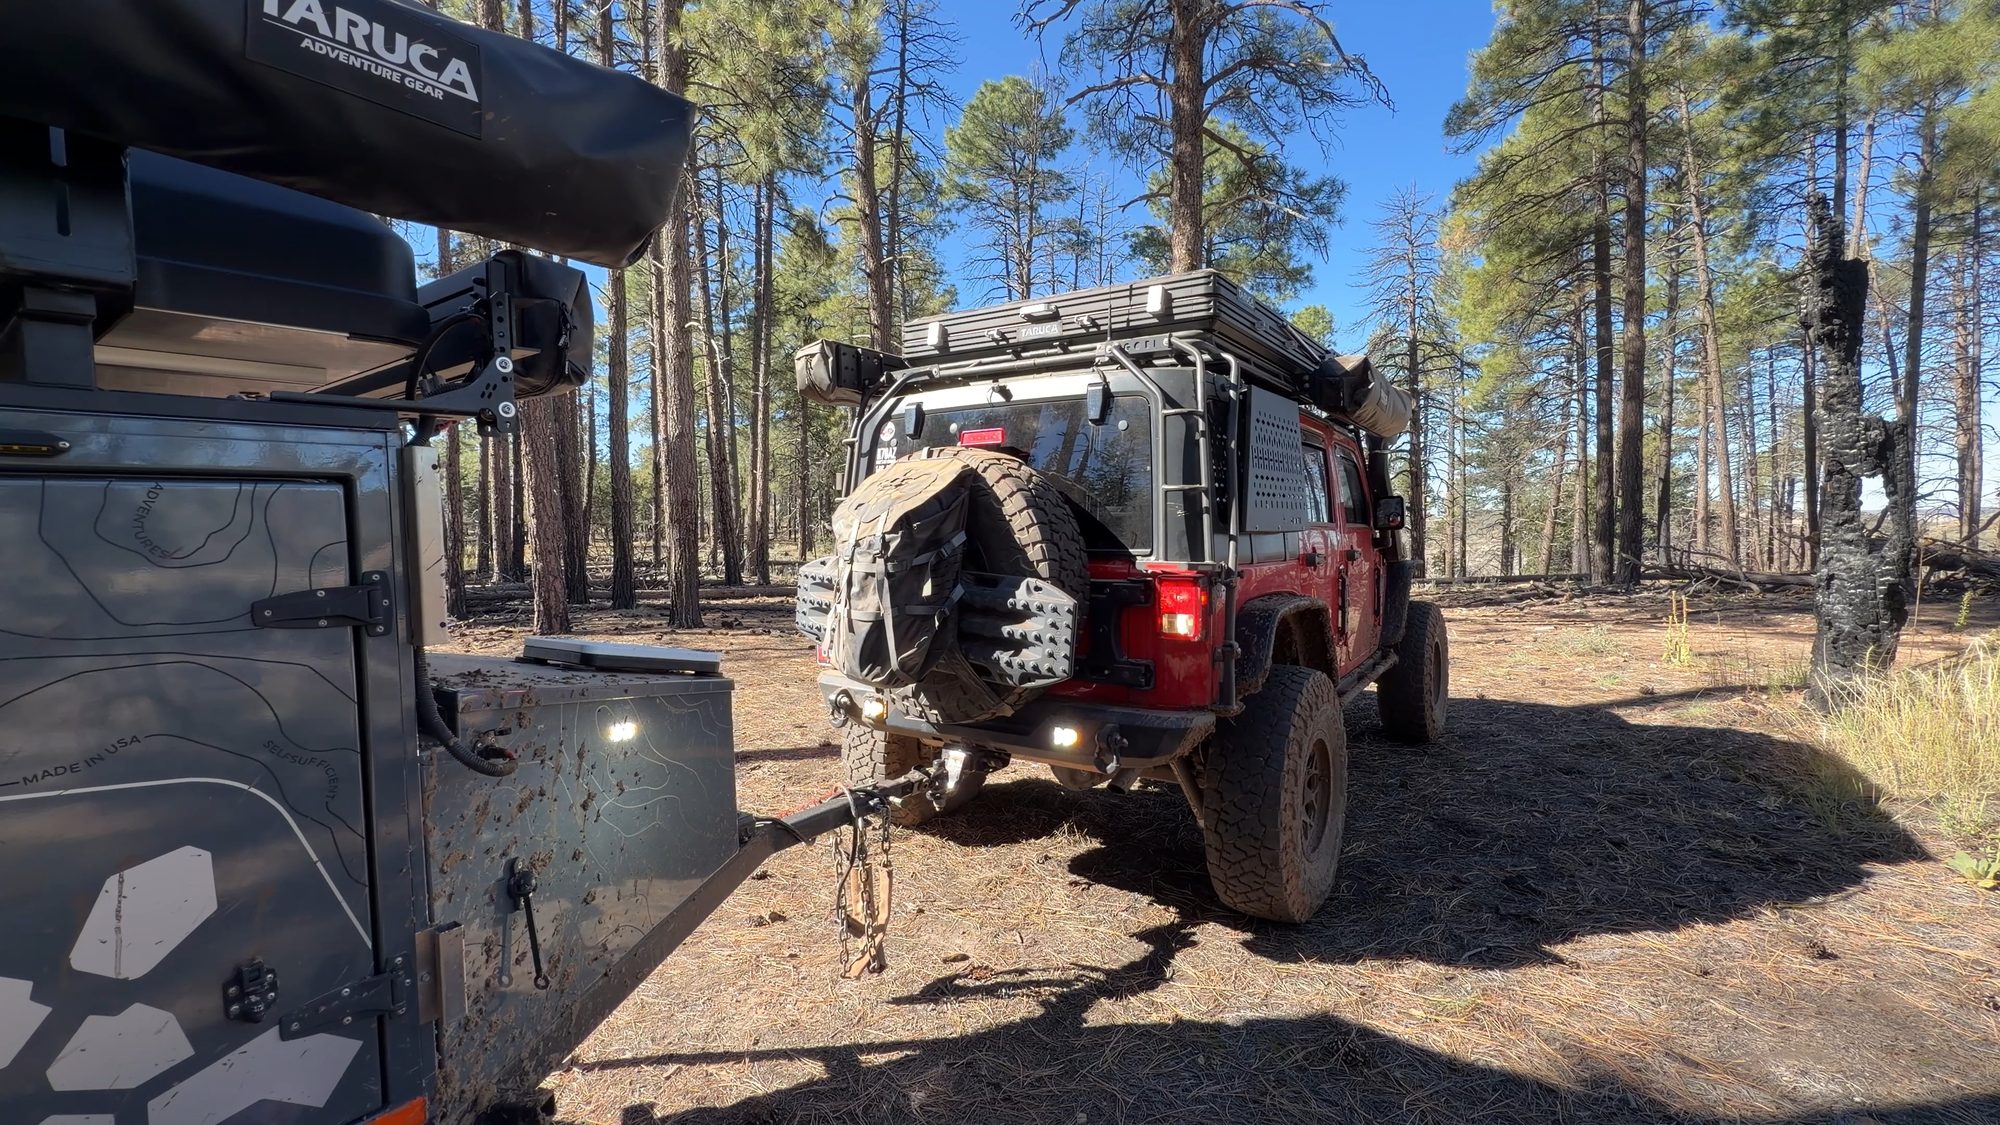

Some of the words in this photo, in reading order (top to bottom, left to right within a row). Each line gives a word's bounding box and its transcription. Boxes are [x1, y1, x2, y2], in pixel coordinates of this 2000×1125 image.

[300, 37, 401, 84] ADVENTURE
[404, 77, 444, 100] GEAR
[1020, 324, 1059, 337] TARUCA
[132, 481, 170, 559] ADVENTURES
[22, 762, 82, 786] MADE
[84, 753, 105, 768] IN
[104, 735, 142, 754] USA
